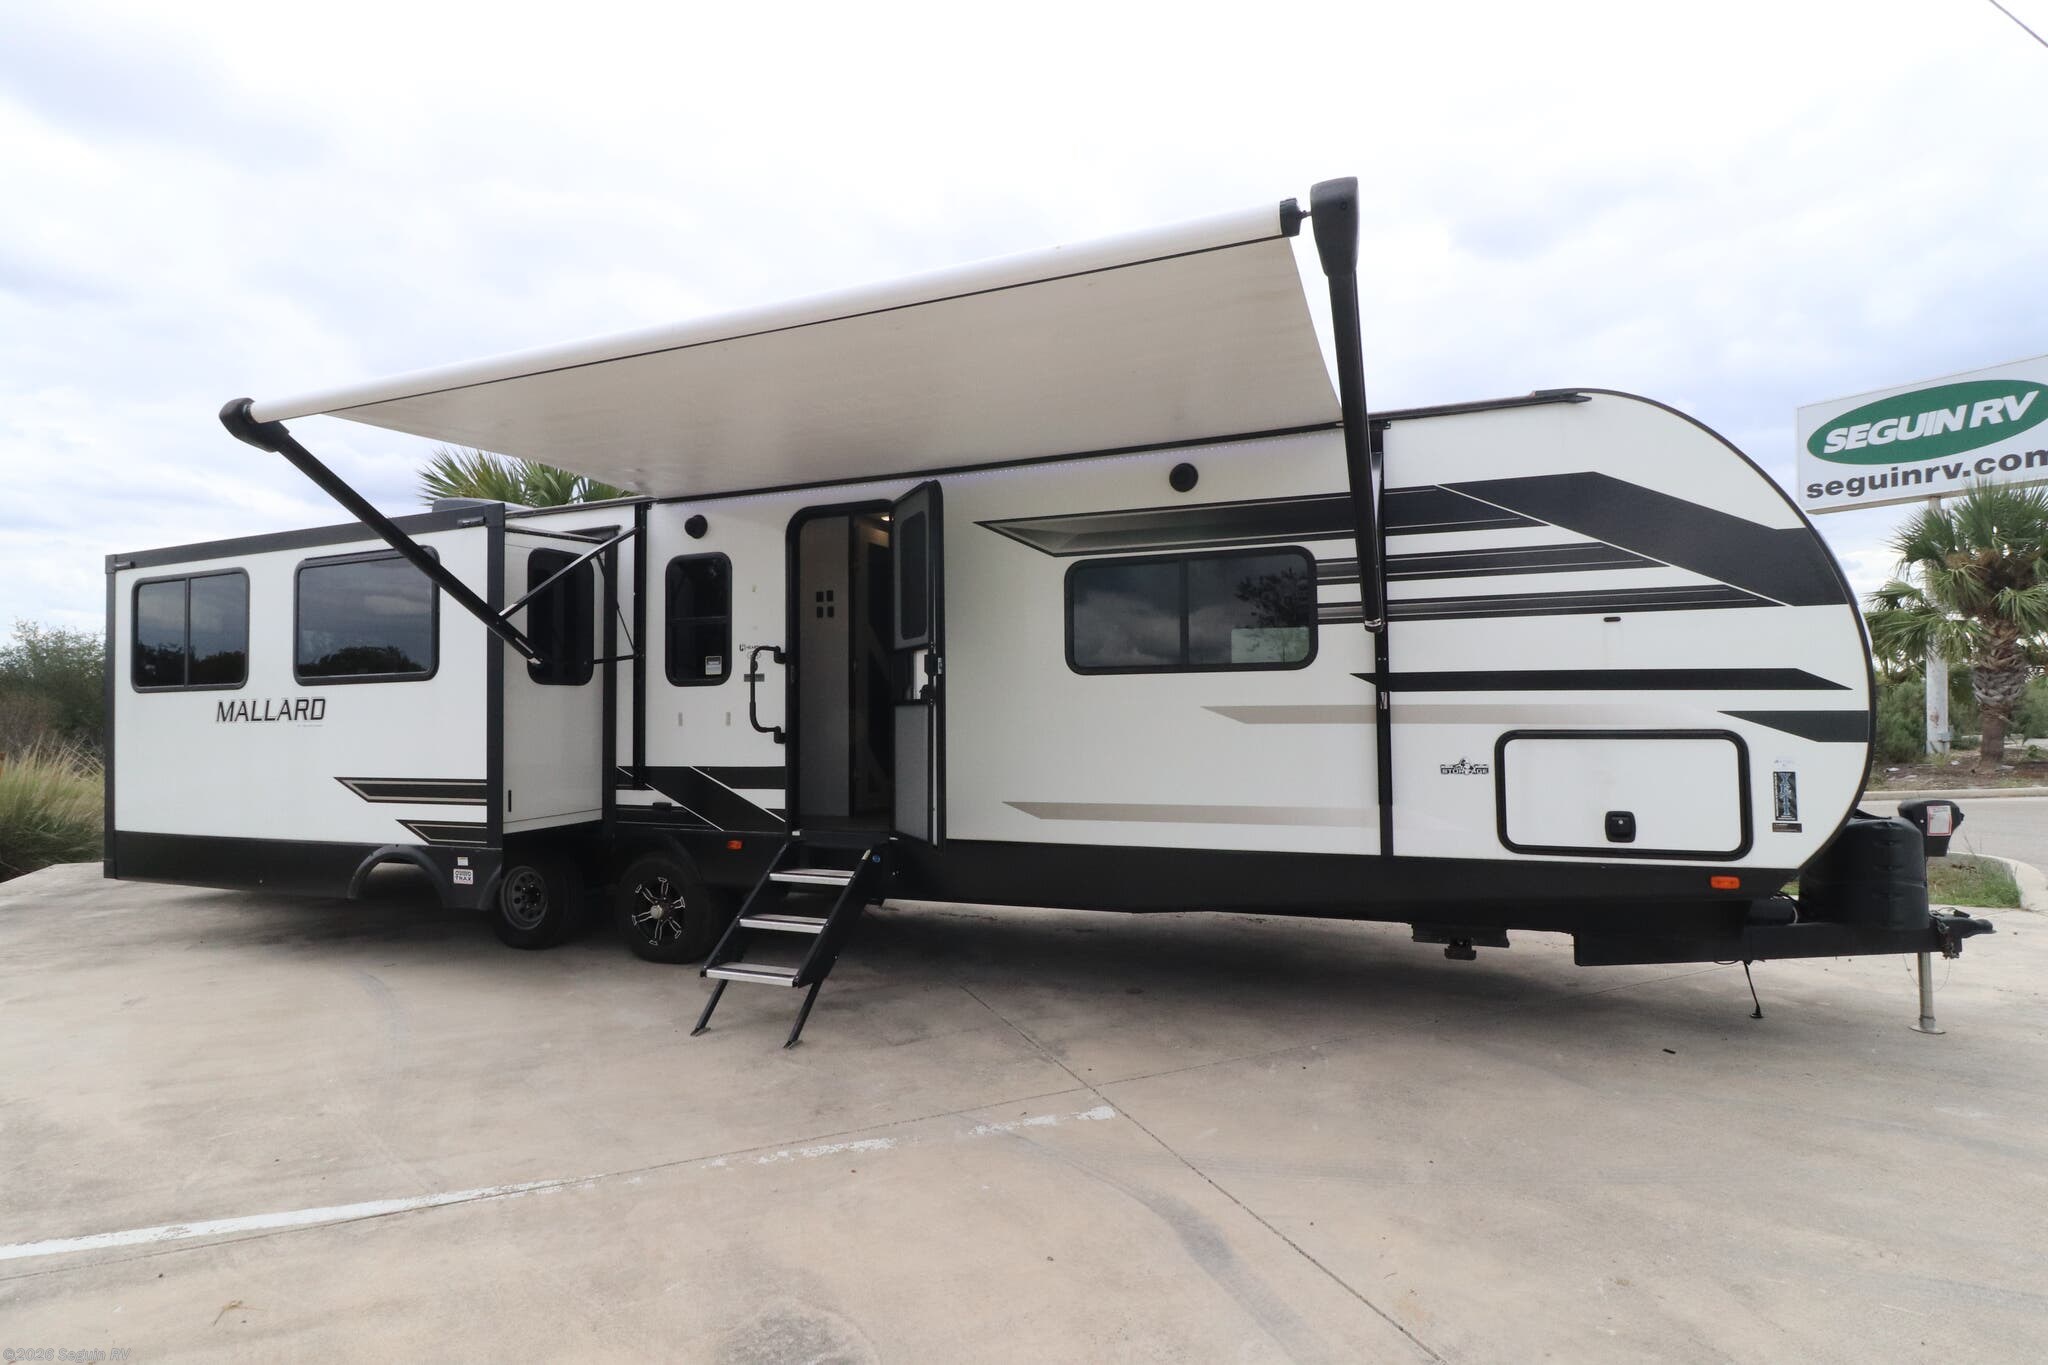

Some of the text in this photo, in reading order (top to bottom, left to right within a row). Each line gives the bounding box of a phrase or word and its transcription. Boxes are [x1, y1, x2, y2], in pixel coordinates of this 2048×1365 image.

[1823, 390, 2039, 454] SEGUIN RV
[216, 698, 326, 722] MALLARD
